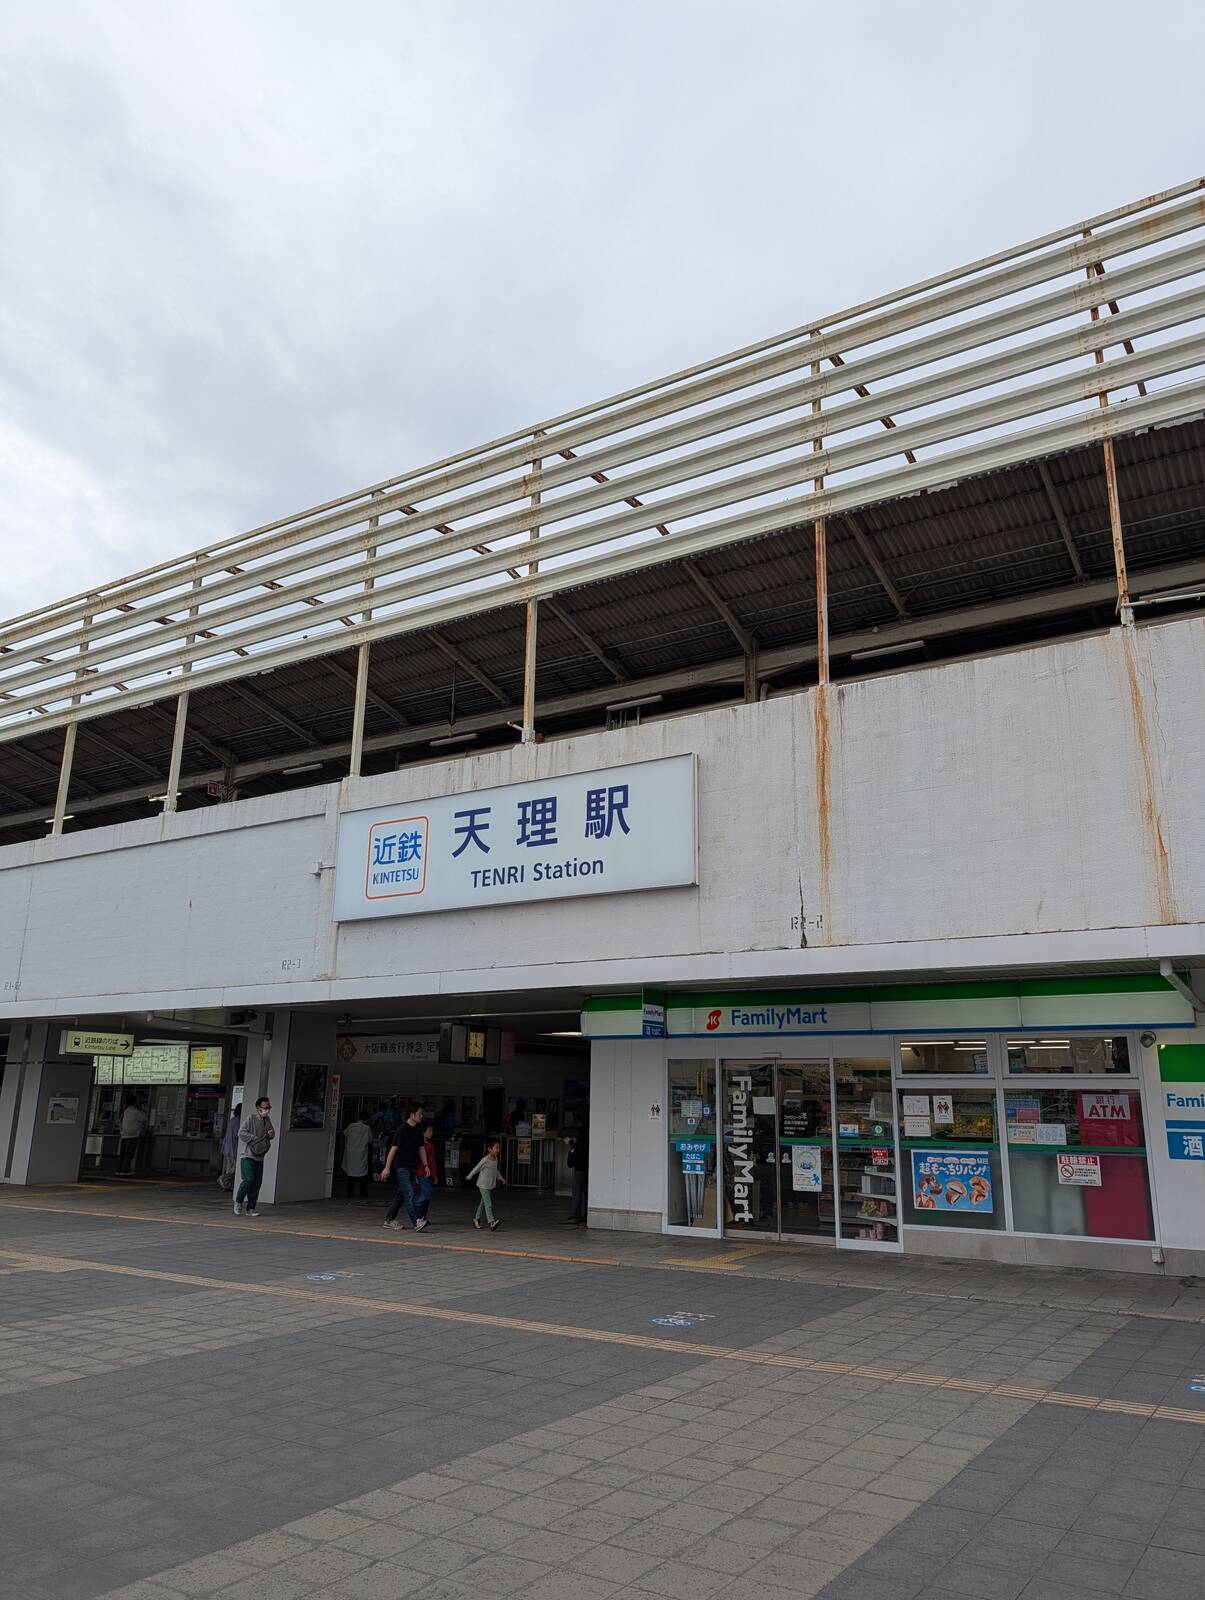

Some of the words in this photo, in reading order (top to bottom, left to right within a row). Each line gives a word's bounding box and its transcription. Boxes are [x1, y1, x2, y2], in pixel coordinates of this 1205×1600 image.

[452, 784, 631, 858] 天理駅
[373, 830, 423, 866] 近鉄
[372, 867, 420, 886] KINTETSU
[471, 865, 525, 889] TENRI
[534, 857, 605, 885] Station
[731, 1007, 827, 1029] FamilyMart
[85, 1037, 119, 1045] 近鉄線のりば
[1088, 1104, 1127, 1118] ATM
[680, 1143, 707, 1152] おみやげ
[728, 1076, 754, 1222] FamilyMart
[1182, 1135, 1204, 1157] 酒
